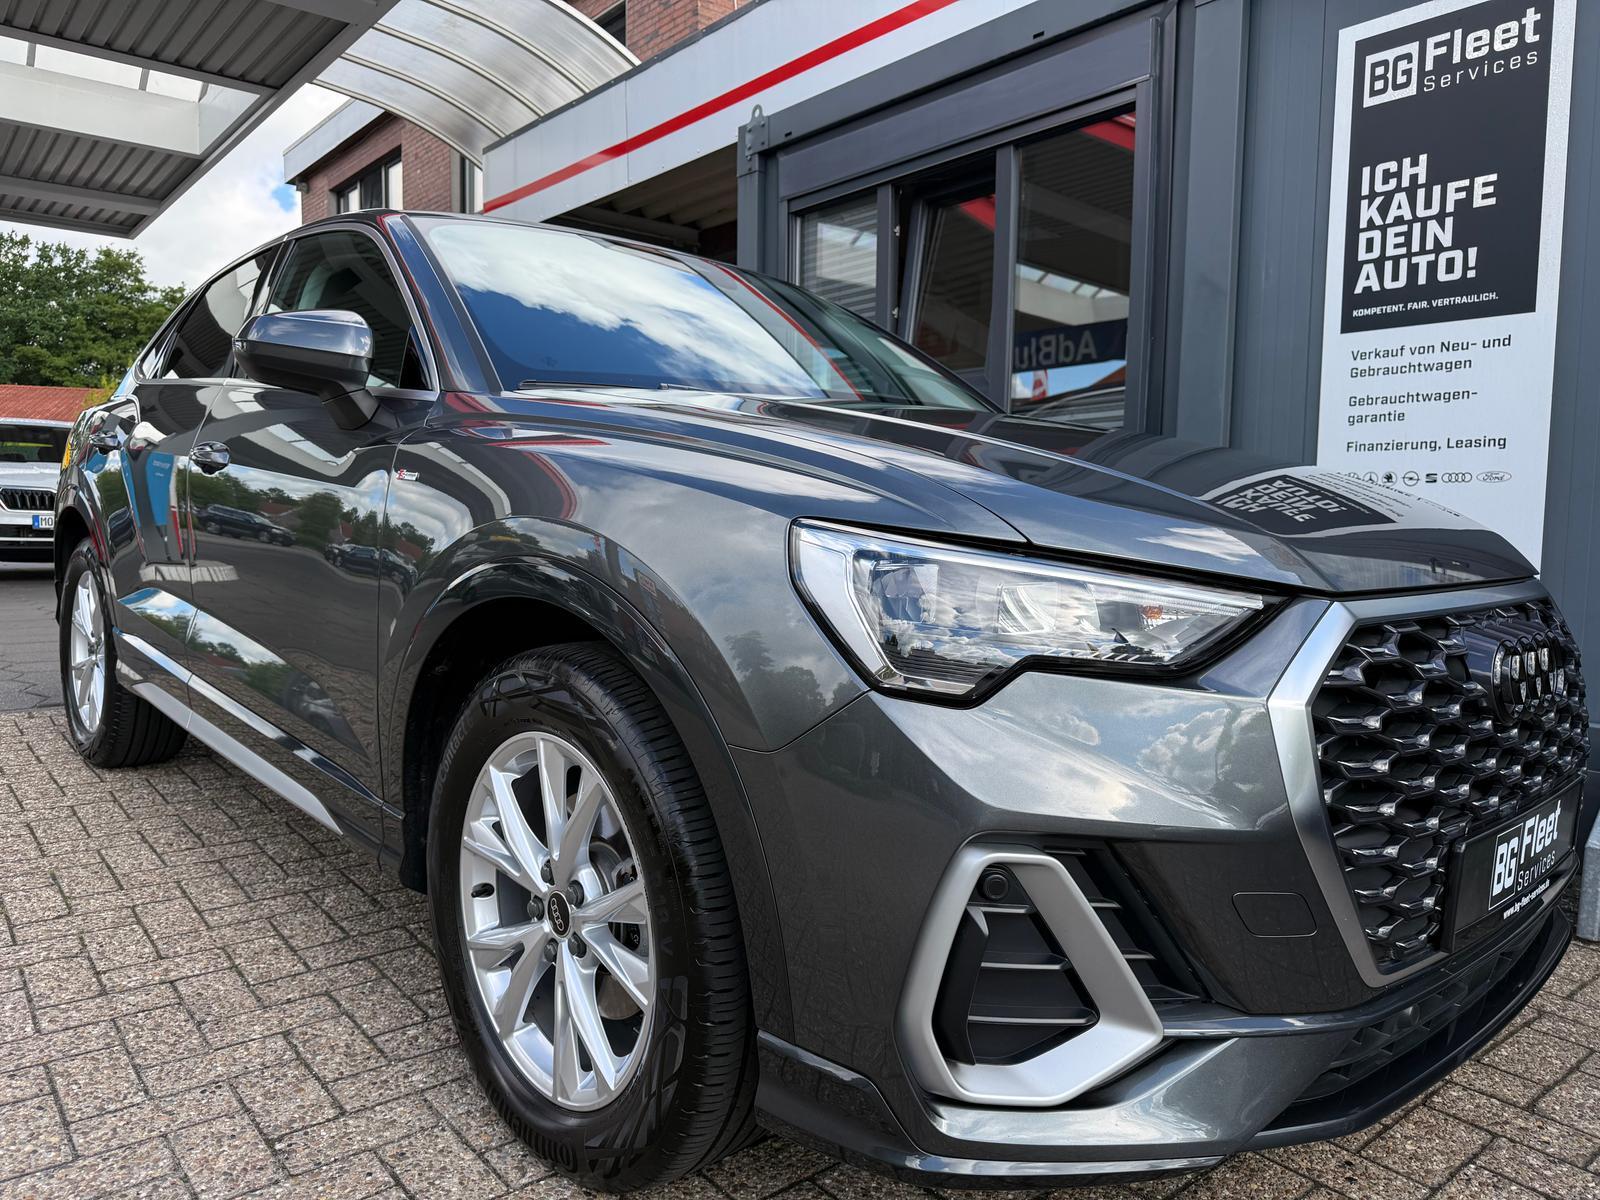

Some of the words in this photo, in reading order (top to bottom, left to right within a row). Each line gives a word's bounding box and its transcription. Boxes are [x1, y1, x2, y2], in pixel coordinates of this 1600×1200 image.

[1366, 49, 1416, 101] BG
[1424, 7, 1541, 71] Fleet
[1423, 51, 1538, 92] Services
[1360, 153, 1428, 196] ICH
[1359, 173, 1498, 229] KAUFE
[1357, 216, 1453, 262] DEIN
[1353, 247, 1478, 295] AUTO!
[1352, 303, 1406, 317] KOMPETENT.
[1407, 300, 1430, 311] FAIR.
[1432, 291, 1499, 307] VERTRAULICH.
[1351, 345, 1406, 361] Verkauf
[1409, 344, 1435, 356] von
[1440, 340, 1478, 353] Neu-
[1482, 334, 1512, 349] und
[1350, 359, 1473, 379] Gebrauchtwagen
[1347, 410, 1405, 426] garantie
[1348, 389, 1478, 407] Gebrauchtwagen-
[1346, 438, 1442, 453] Finanzierung,
[1446, 435, 1507, 450] Leasing
[1492, 836, 1519, 897] BG
[1520, 800, 1561, 864] Fleet
[1517, 850, 1556, 891] Services
